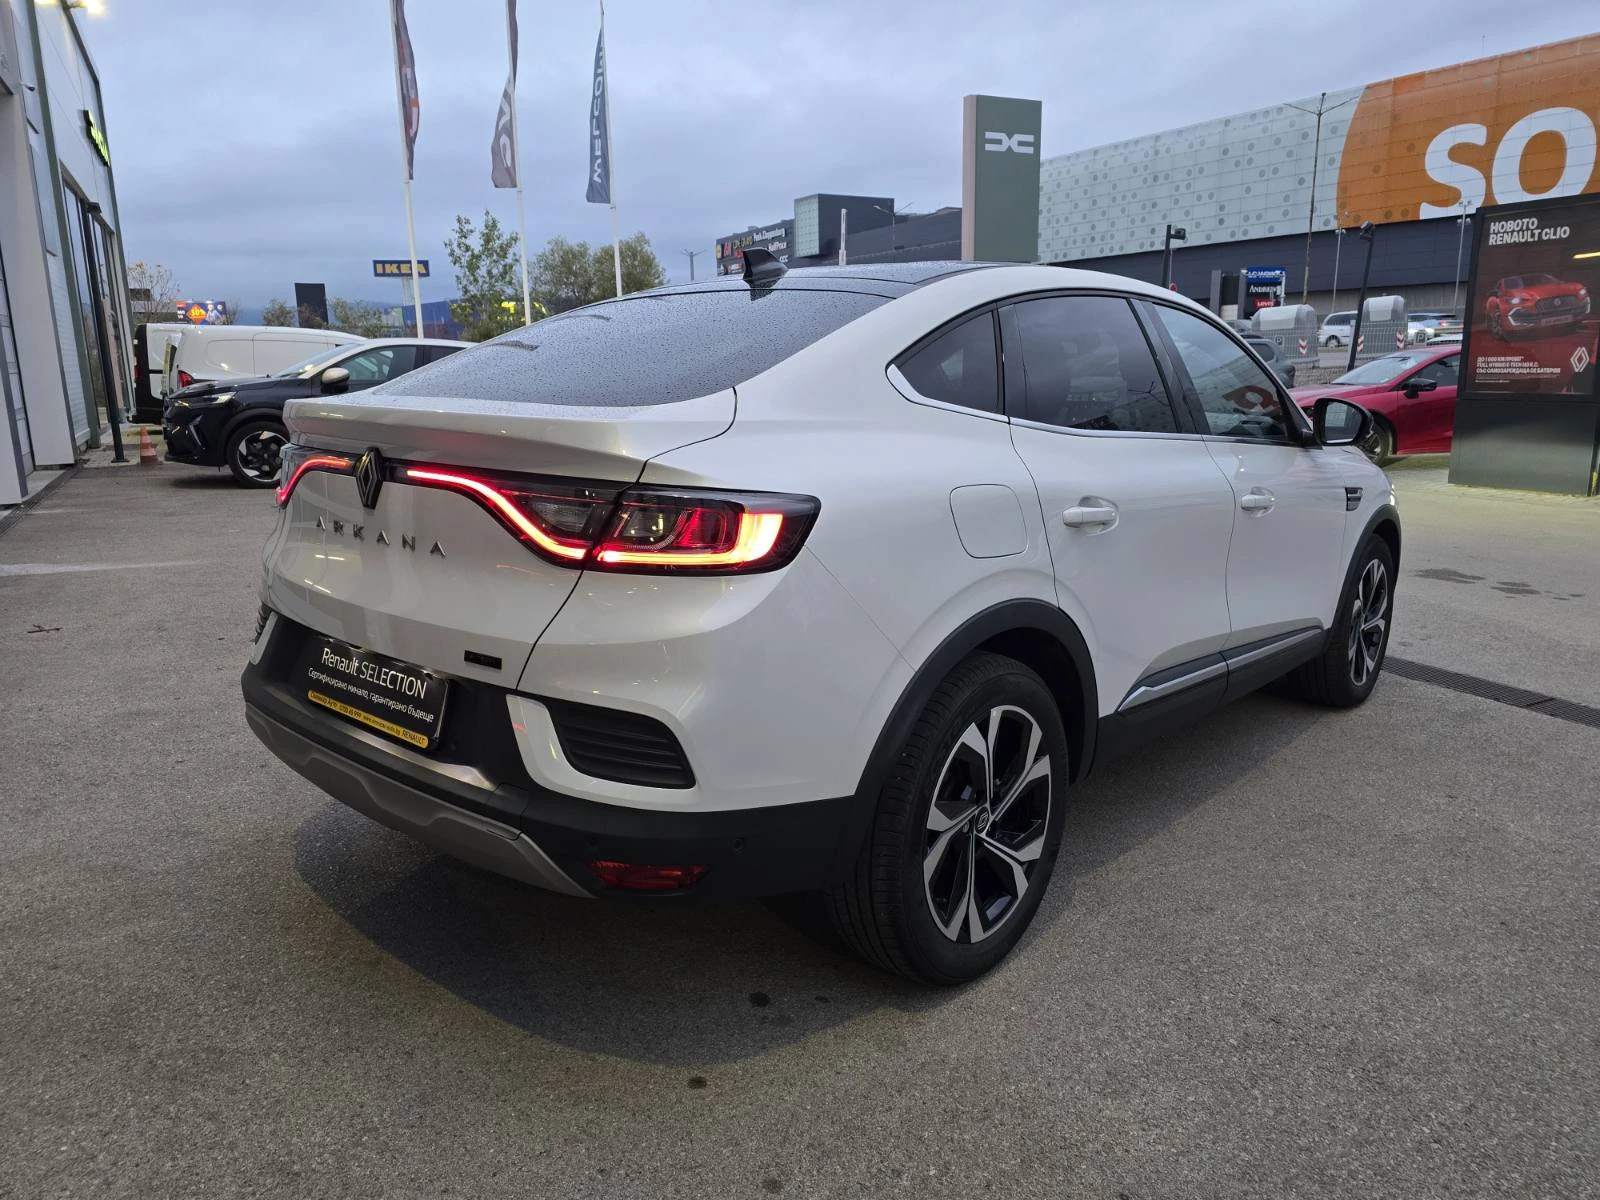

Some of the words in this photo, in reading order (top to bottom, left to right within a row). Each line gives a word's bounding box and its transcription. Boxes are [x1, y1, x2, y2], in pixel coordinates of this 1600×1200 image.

[1489, 217, 1538, 234] НОВОТО
[1488, 229, 1541, 246] RENAULT
[1541, 226, 1571, 241] CLIO
[376, 263, 427, 274] IKEA
[316, 515, 447, 557] ARKANA
[321, 647, 359, 676] Renault
[359, 661, 427, 700] SELECTION
[407, 704, 434, 723] бъдеще
